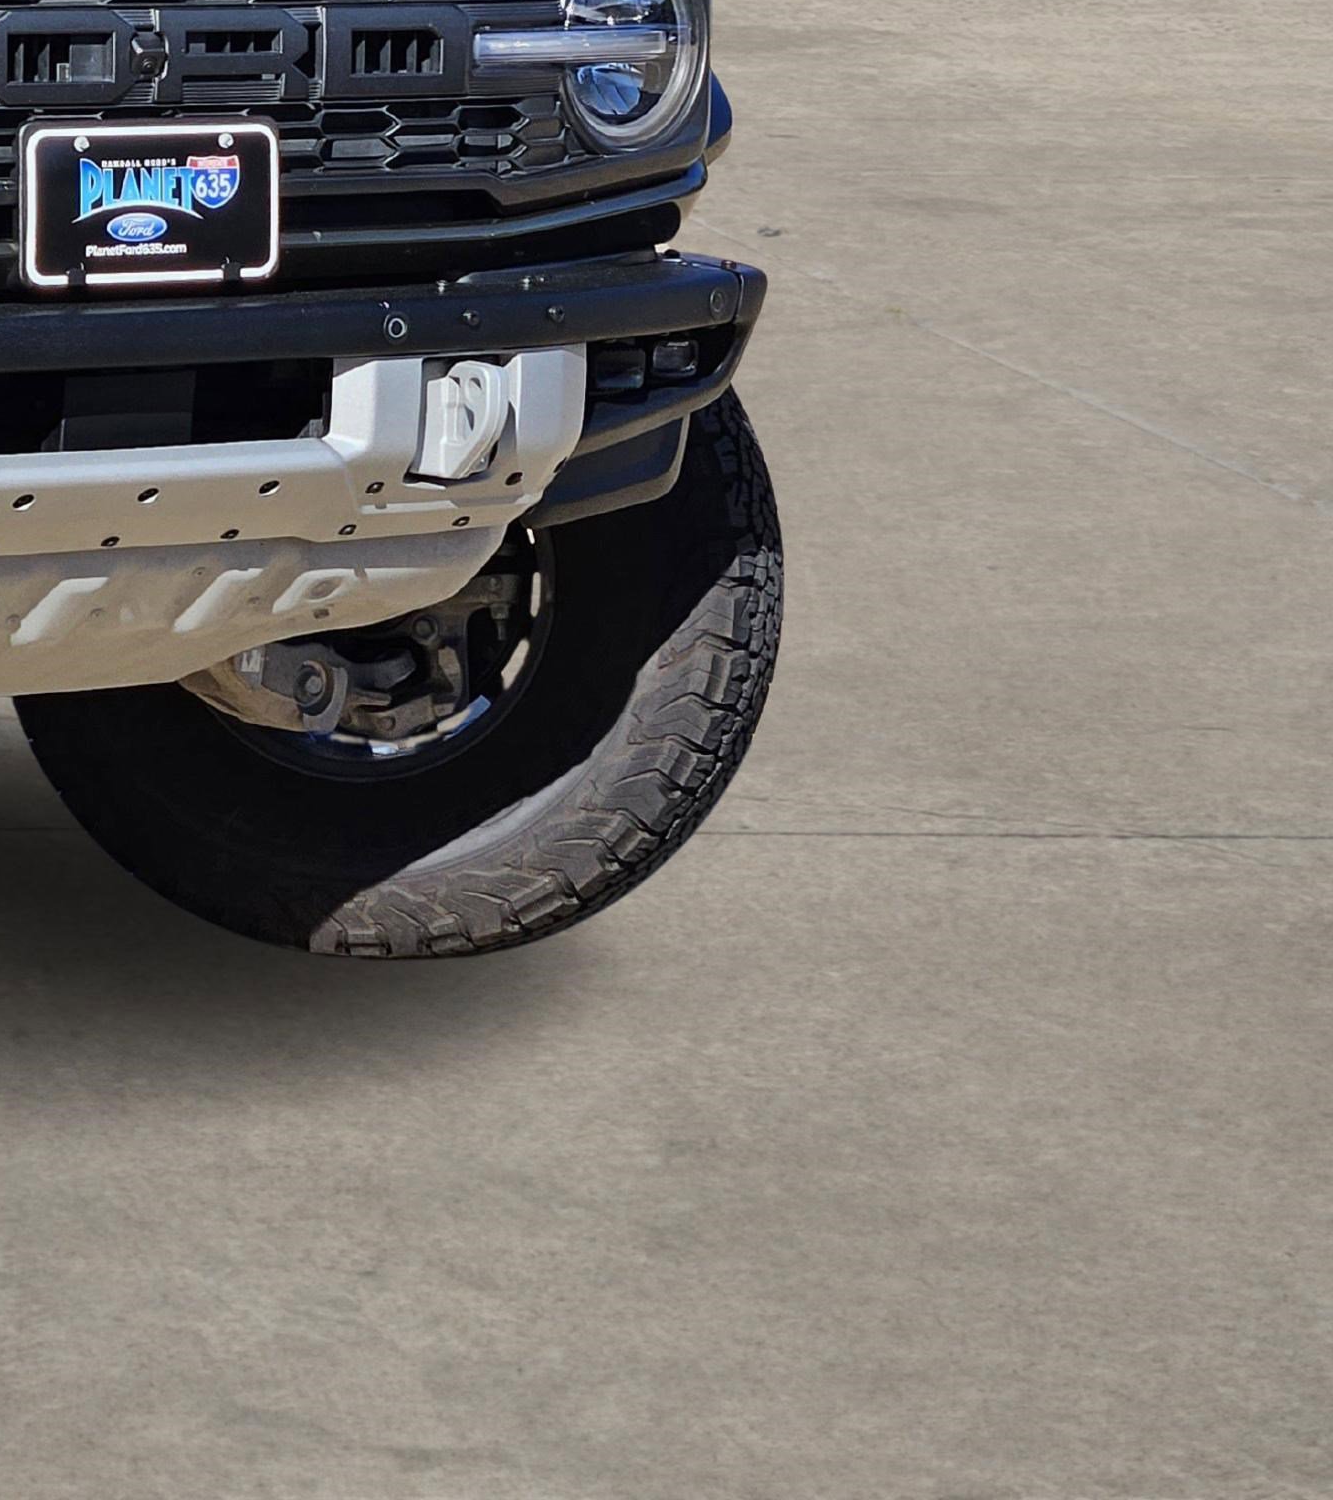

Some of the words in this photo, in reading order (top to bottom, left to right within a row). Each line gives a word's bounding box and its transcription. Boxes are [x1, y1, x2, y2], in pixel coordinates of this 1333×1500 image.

[80, 158, 195, 218] PLANET
[195, 173, 231, 199] 635
[118, 217, 155, 237] Ford
